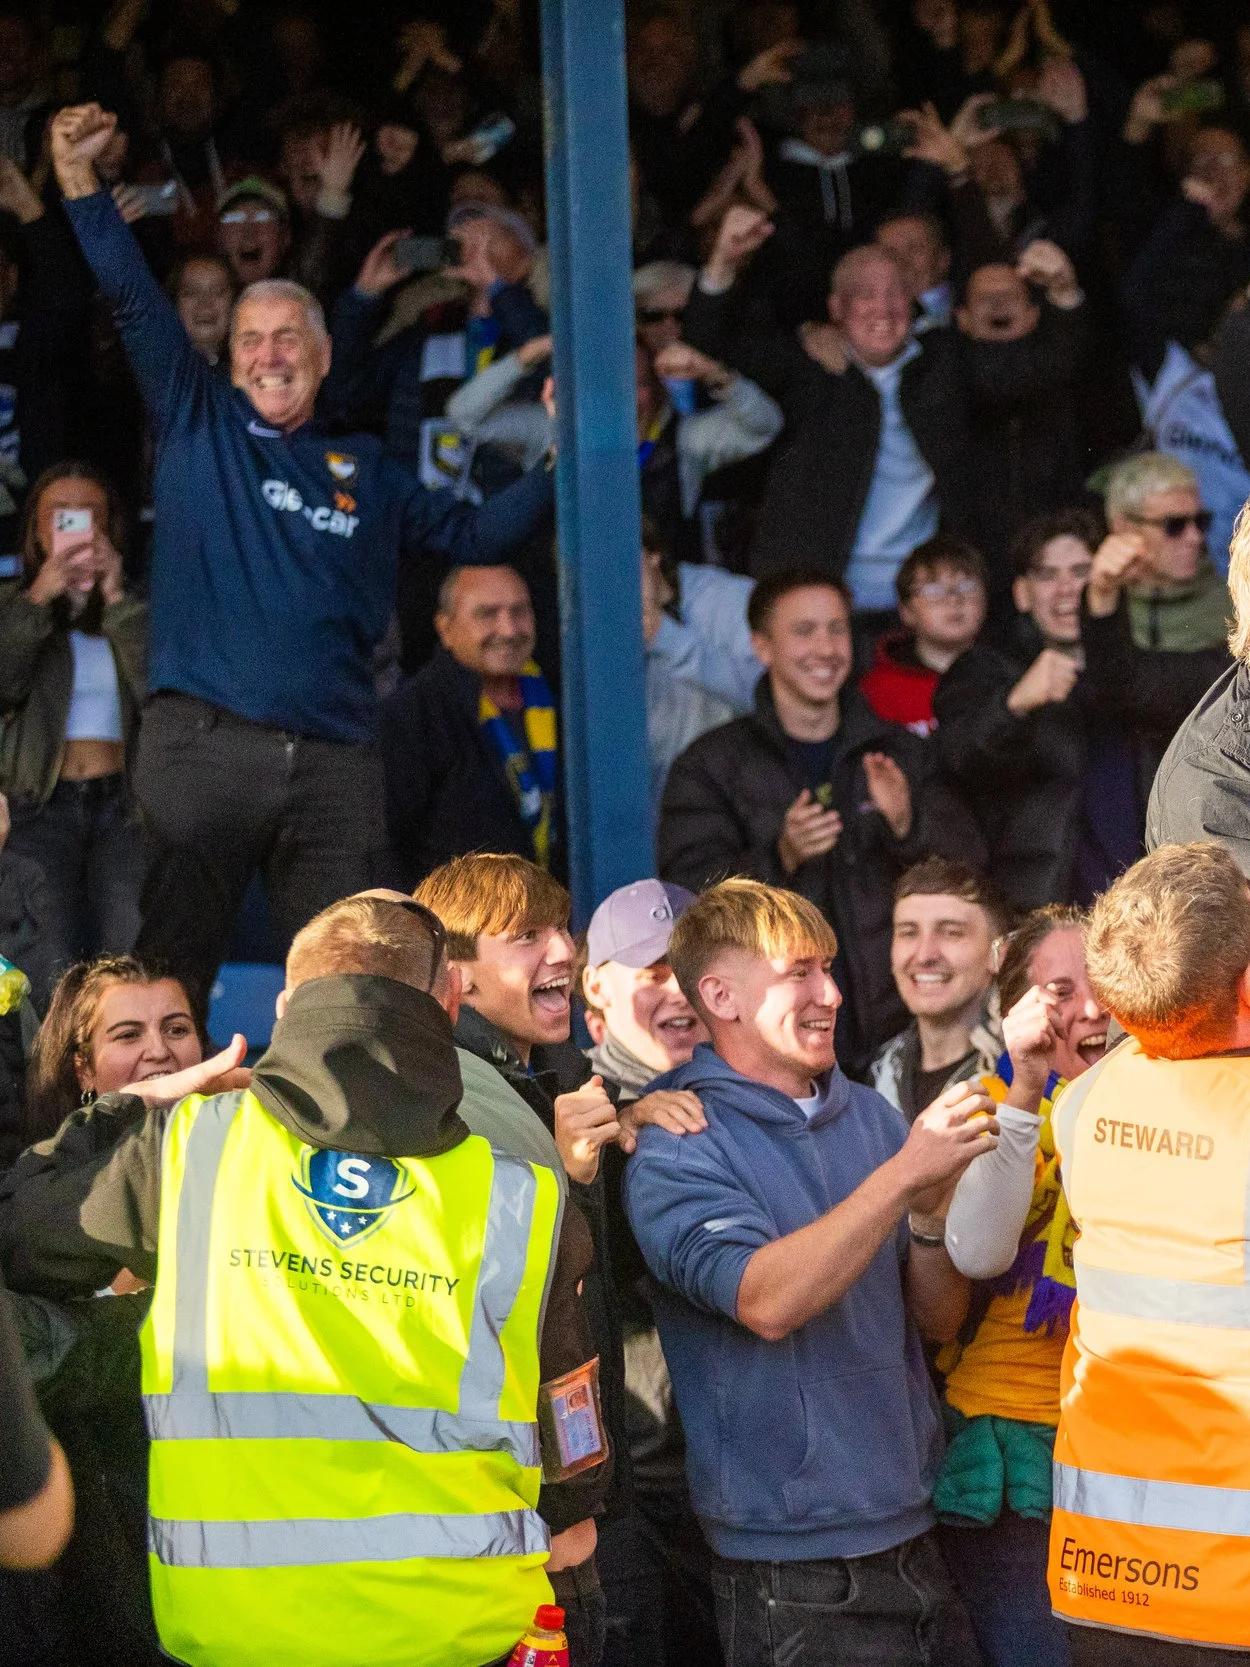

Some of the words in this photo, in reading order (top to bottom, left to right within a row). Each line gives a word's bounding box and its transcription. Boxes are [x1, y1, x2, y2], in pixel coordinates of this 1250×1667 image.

[261, 479, 360, 538] Glecar
[1093, 1117, 1216, 1161] STEWARD
[332, 1158, 372, 1200] S
[229, 1249, 333, 1277] STEVENS
[339, 1261, 461, 1296] SECURITY
[261, 1276, 370, 1301] SOLUTIONS
[381, 1293, 417, 1308] LTD
[1060, 1537, 1200, 1591] Emersons
[1059, 1577, 1116, 1601] Established
[1121, 1590, 1150, 1607] 1912
